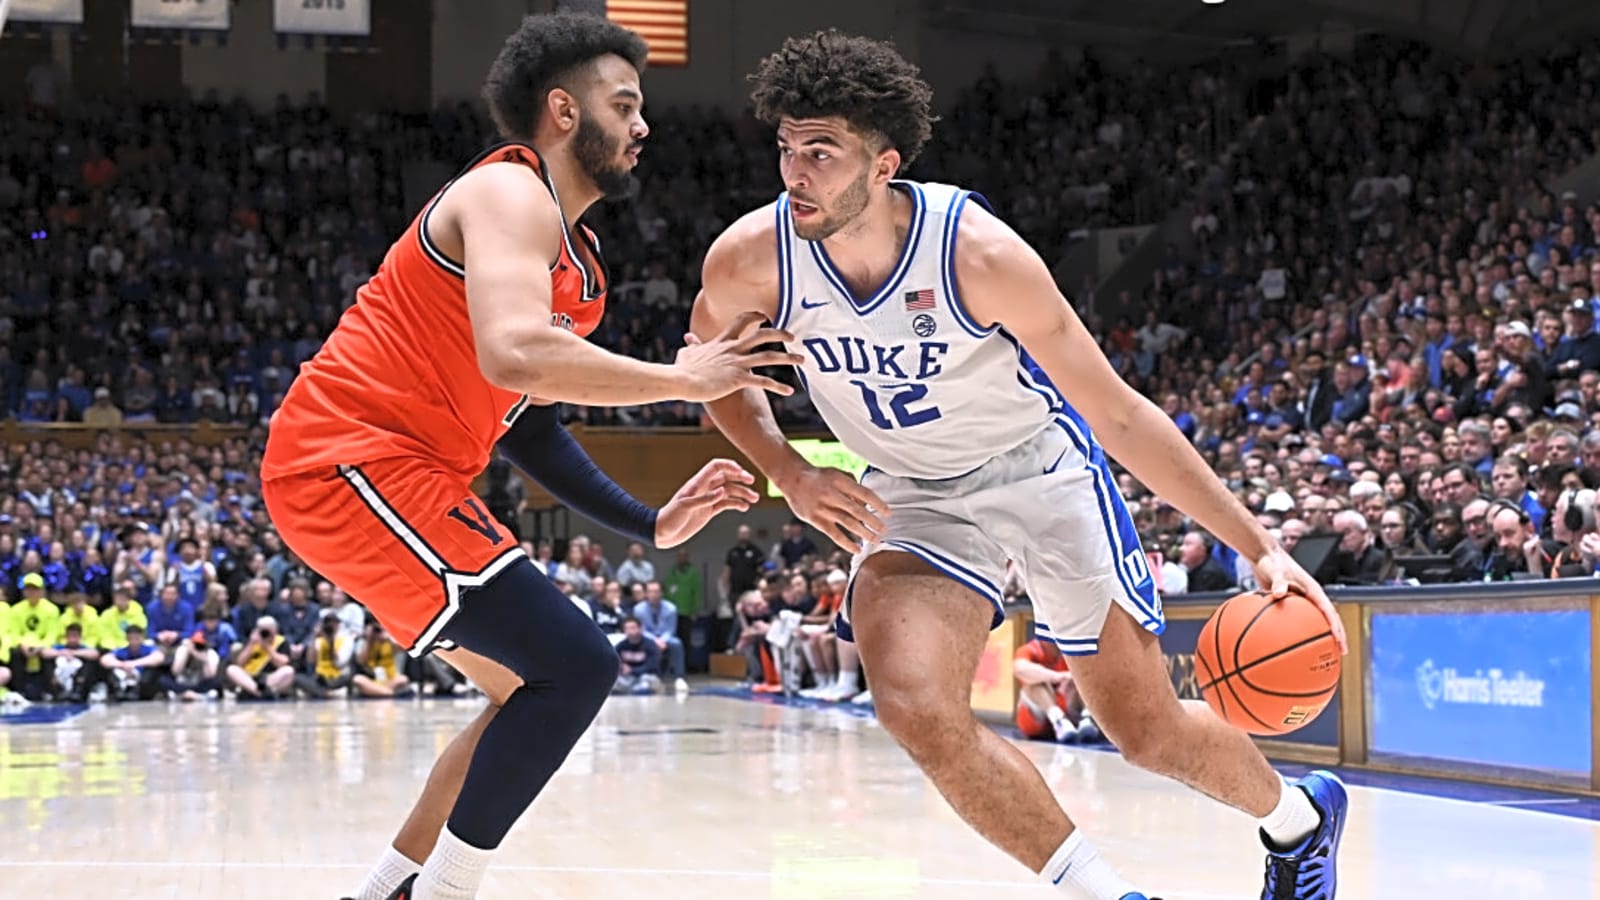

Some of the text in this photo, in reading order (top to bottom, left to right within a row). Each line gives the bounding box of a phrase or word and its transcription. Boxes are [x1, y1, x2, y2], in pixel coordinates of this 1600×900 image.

[802, 337, 949, 379] DUKE
[849, 380, 942, 430] 12
[447, 498, 504, 546] V
[1124, 548, 1149, 588] D
